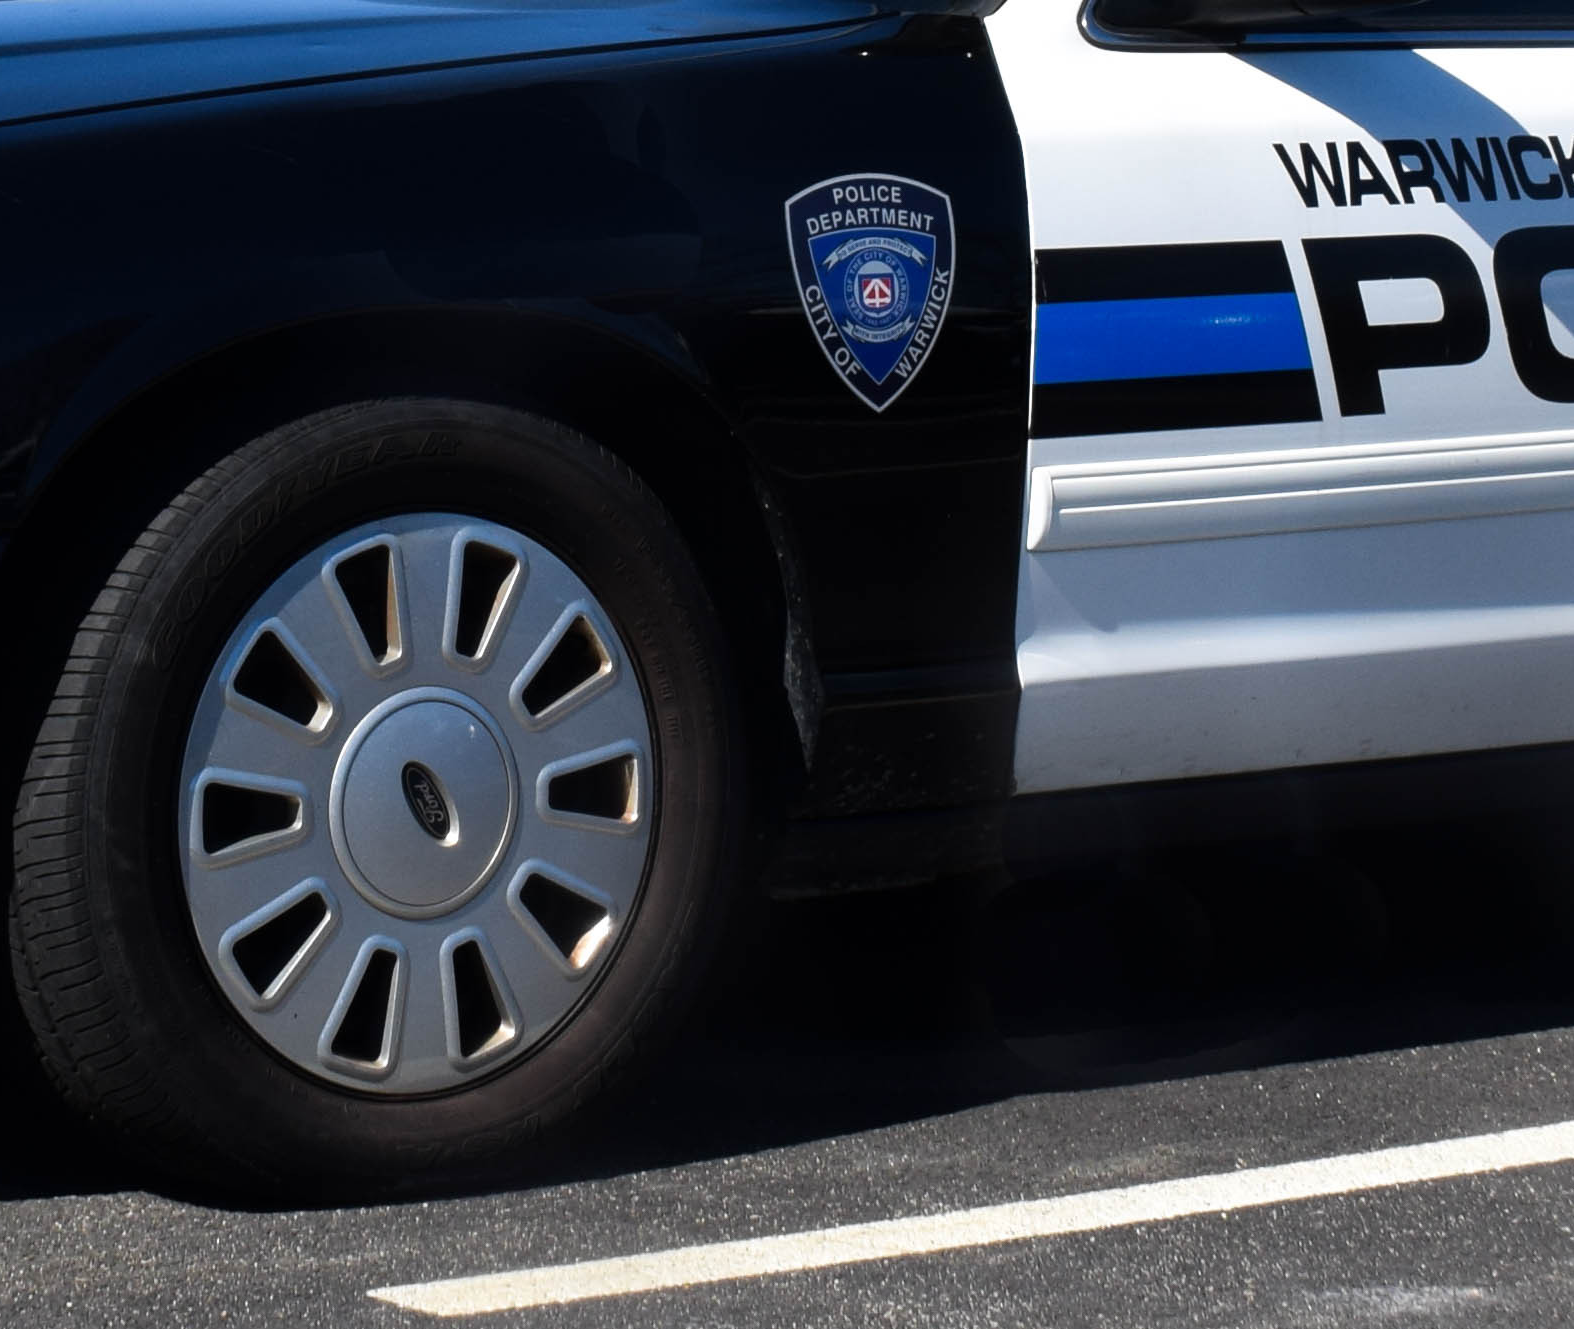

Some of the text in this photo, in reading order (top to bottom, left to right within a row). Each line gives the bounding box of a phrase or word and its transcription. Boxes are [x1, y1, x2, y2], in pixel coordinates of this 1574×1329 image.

[832, 184, 902, 205] POLICE
[806, 207, 935, 235] DEPARTMENT
[864, 252, 882, 260] CITY
[805, 284, 862, 377] CITY OF
[895, 266, 950, 379] WARWICK
